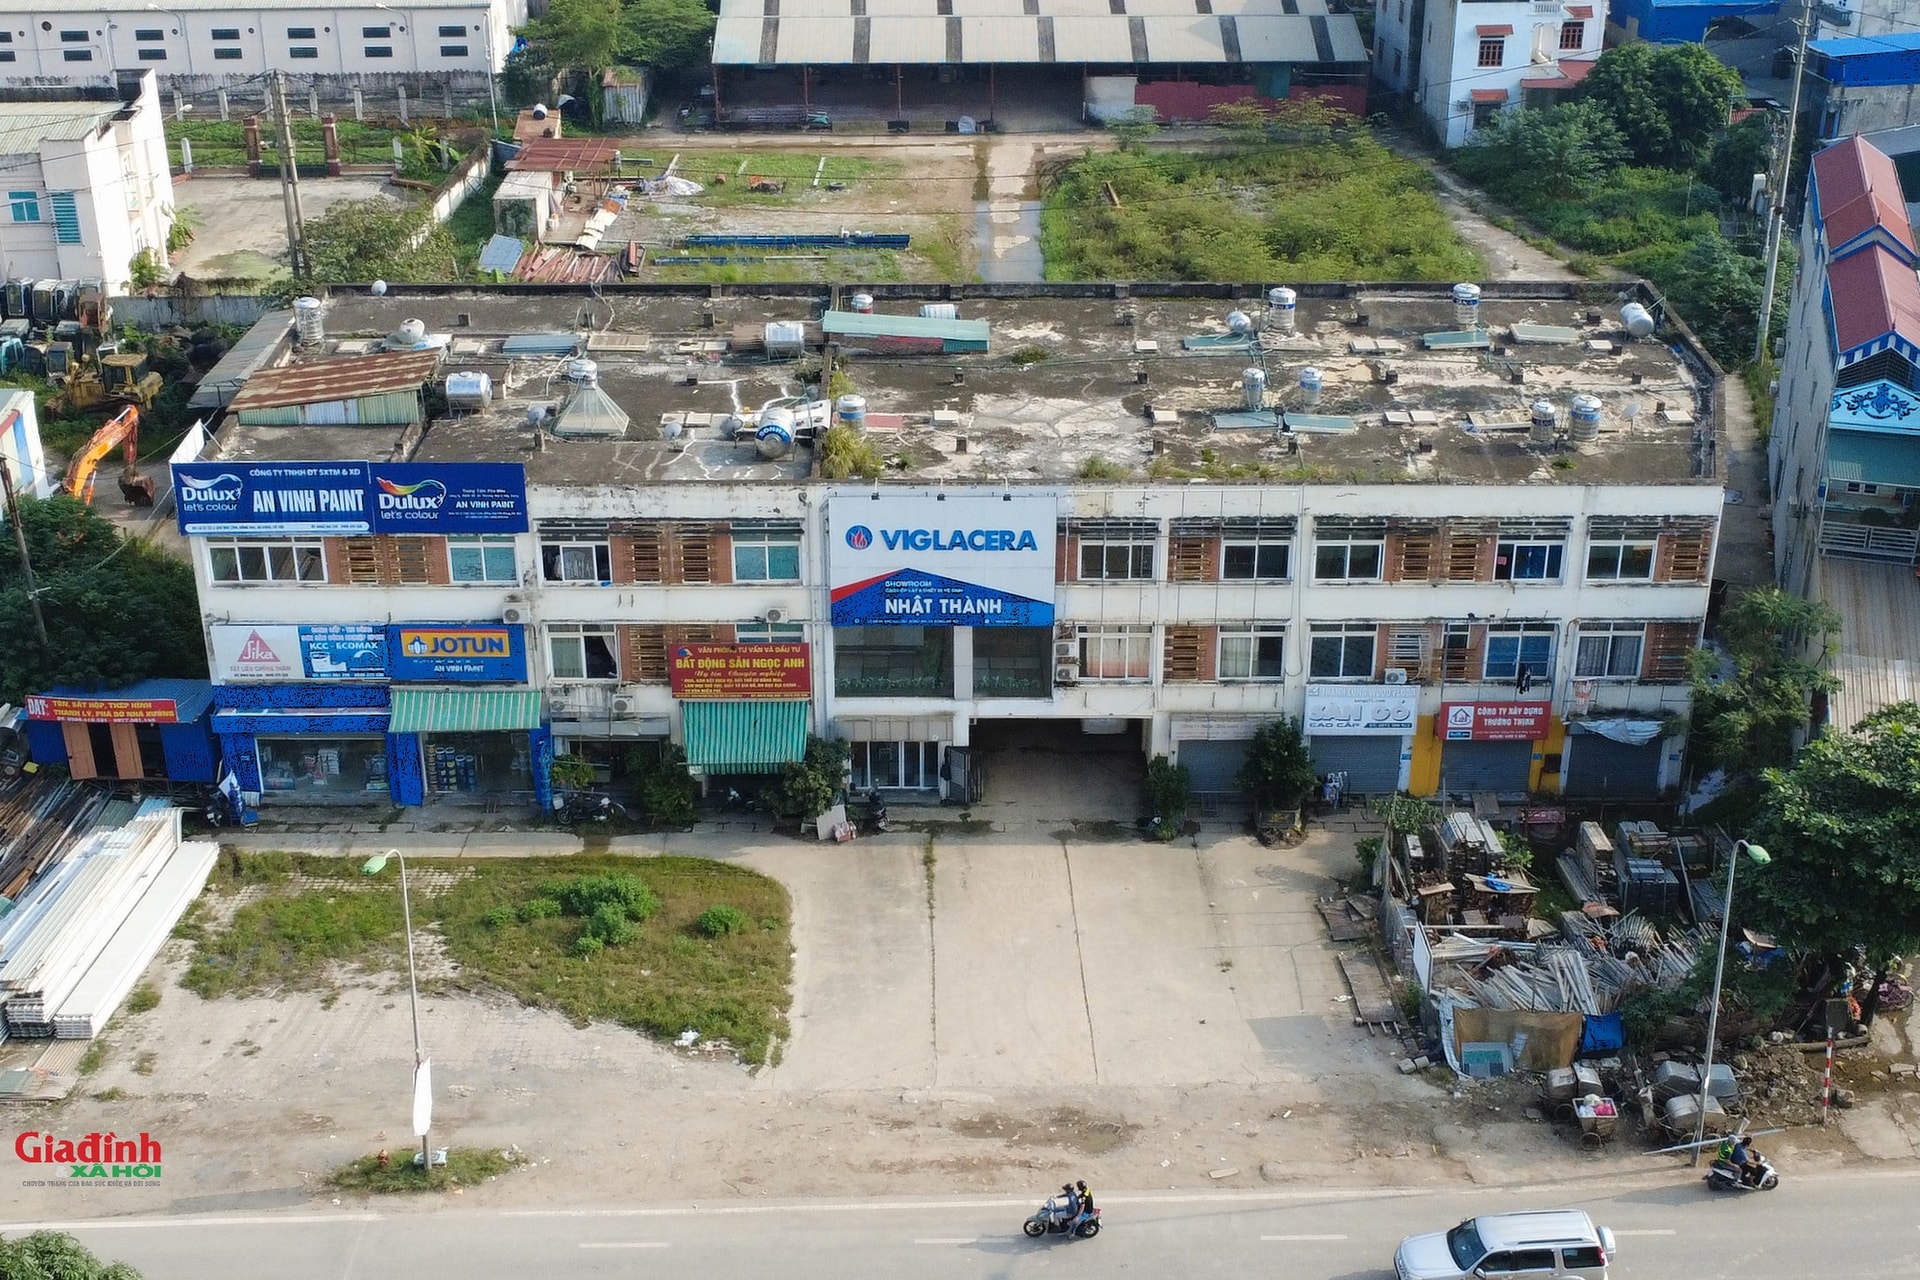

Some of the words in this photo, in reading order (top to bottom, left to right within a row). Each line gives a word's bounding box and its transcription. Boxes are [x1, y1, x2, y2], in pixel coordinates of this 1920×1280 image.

[249, 468, 272, 476] CÔNG
[181, 487, 236, 501] Dulux
[253, 490, 273, 513] AN
[277, 490, 316, 512] VINH
[319, 489, 364, 512] PAINT
[379, 493, 439, 509] Dulux
[184, 503, 205, 512] let's
[205, 504, 238, 512] colour
[381, 510, 402, 519] let's
[404, 510, 439, 519] colour
[880, 529, 1038, 551] VIGLACERA
[885, 595, 933, 616] NHẬT
[939, 595, 1002, 614] THÀNH
[242, 640, 274, 660] Sika
[309, 642, 328, 650] KCC
[336, 642, 378, 650] ECOMAX
[431, 637, 505, 653] JOTUN
[676, 656, 696, 668] BẤT
[697, 657, 726, 670] ĐỘNG
[728, 655, 750, 668] SẢN
[752, 658, 781, 670] NGỌC
[783, 658, 805, 668] ANH
[1477, 707, 1497, 715] CÔNG
